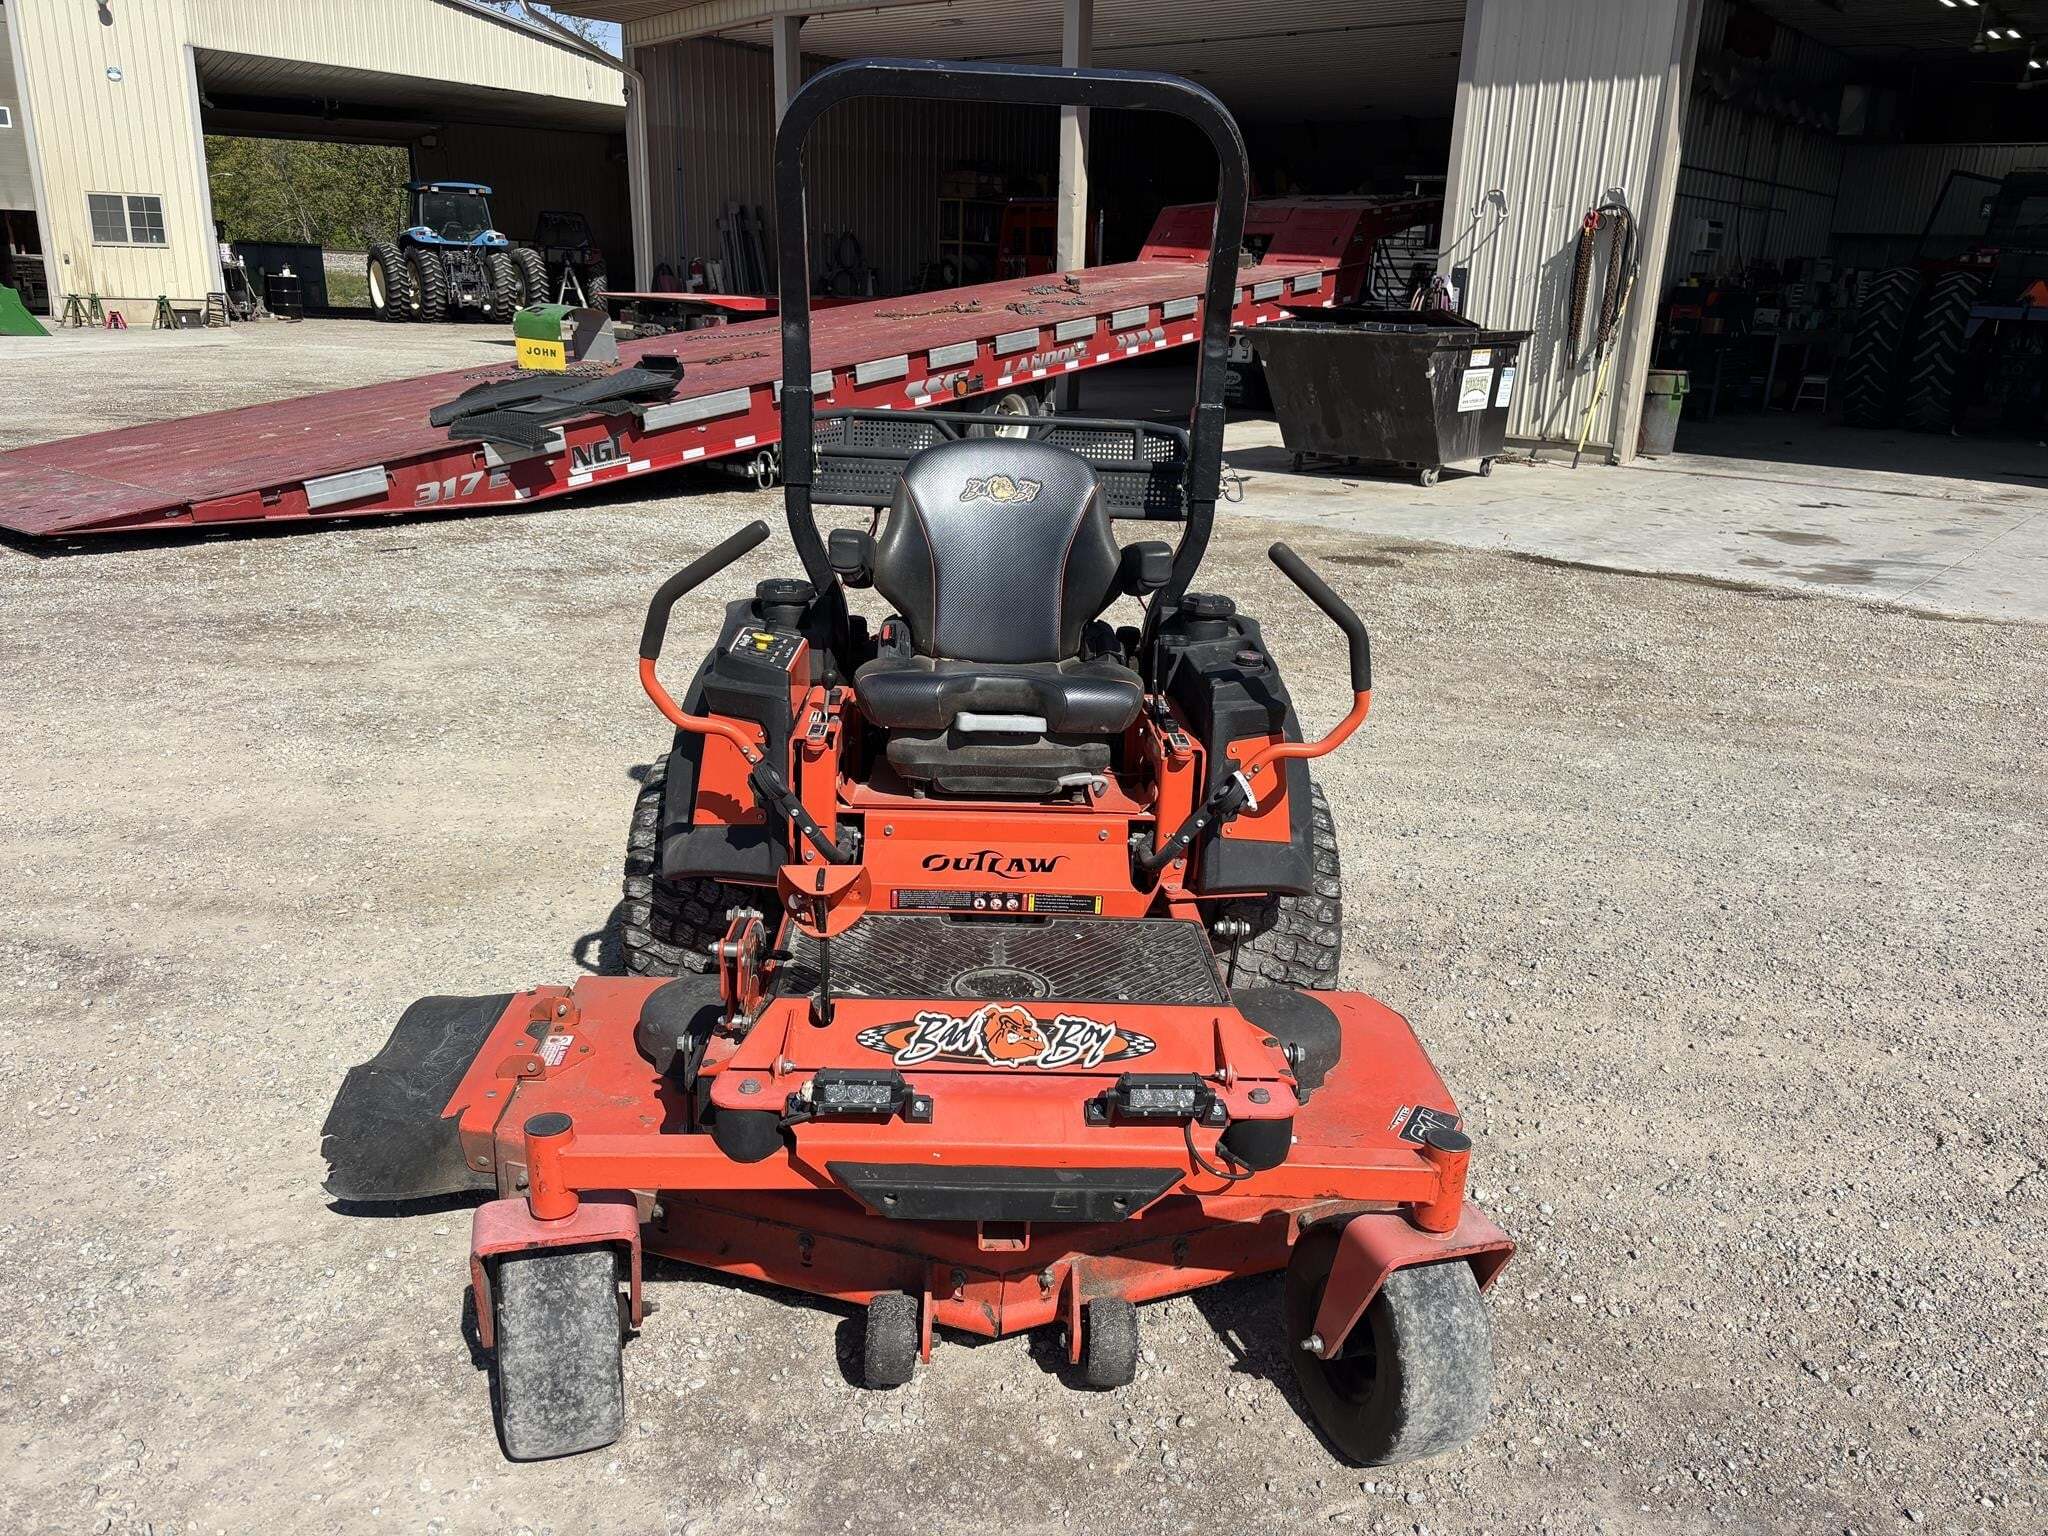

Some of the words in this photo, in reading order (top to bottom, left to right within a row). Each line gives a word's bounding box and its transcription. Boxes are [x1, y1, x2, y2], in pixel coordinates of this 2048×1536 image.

[526, 346, 557, 358] JOHN
[571, 436, 631, 469] NGL
[895, 1011, 981, 1065] Bad
[1038, 1014, 1116, 1068] Boy
